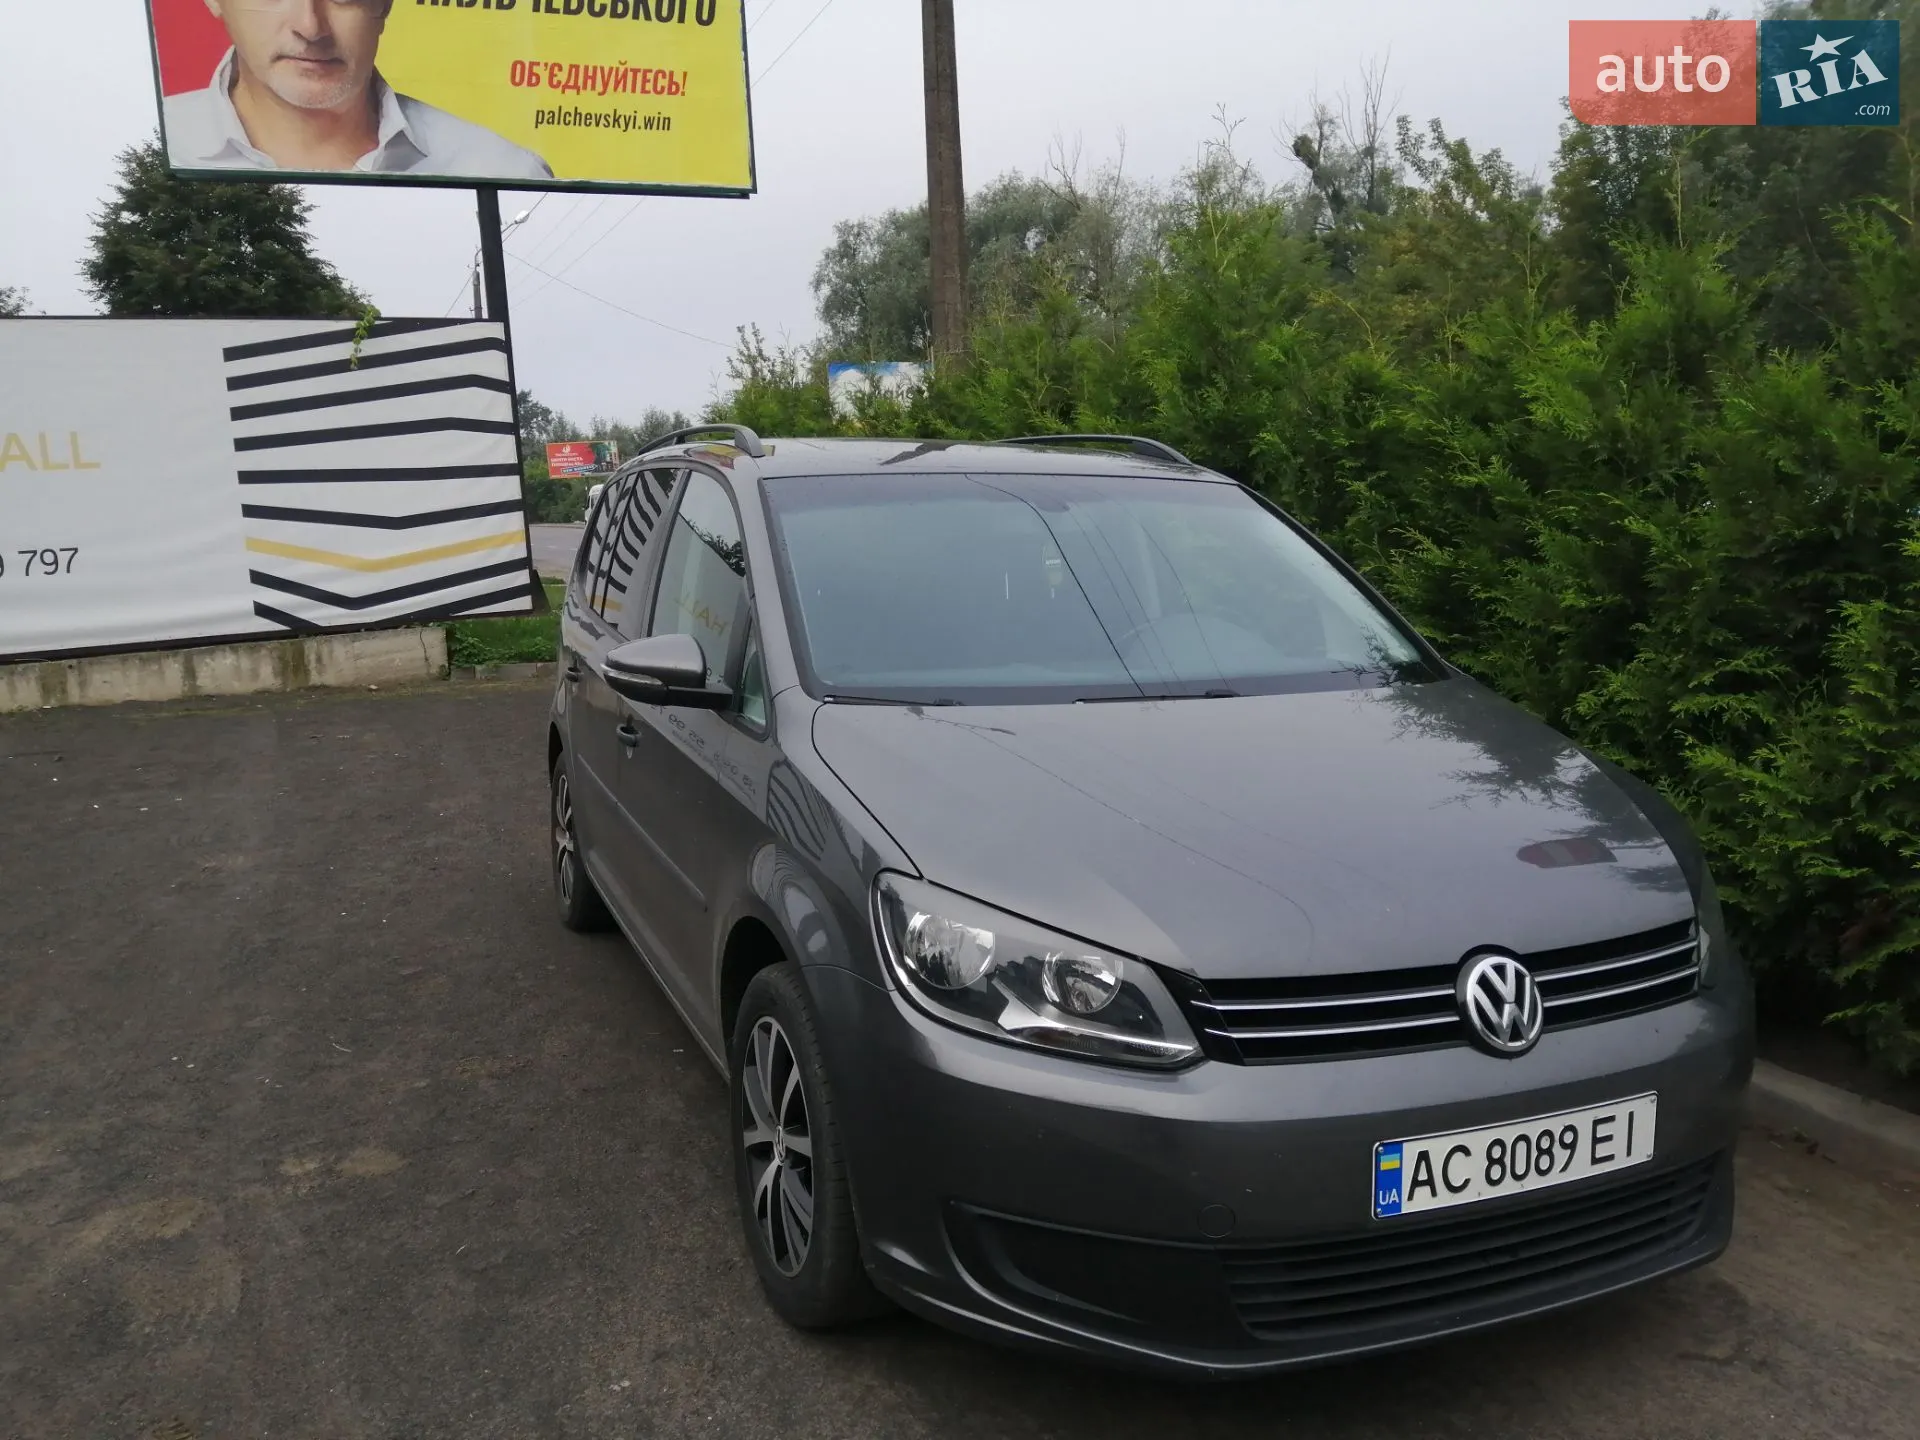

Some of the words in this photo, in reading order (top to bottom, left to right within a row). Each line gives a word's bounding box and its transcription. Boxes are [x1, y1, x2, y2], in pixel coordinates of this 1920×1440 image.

[509, 59, 688, 97] ОБ'ЄДНУЙТЕСЬ!
[534, 105, 672, 132] palchevskyi.win
[17, 547, 79, 577] 797
[1406, 1144, 1472, 1202] AC
[1484, 1123, 1579, 1188] 8089
[1590, 1110, 1635, 1166] EI
[1379, 1188, 1400, 1206] UA
